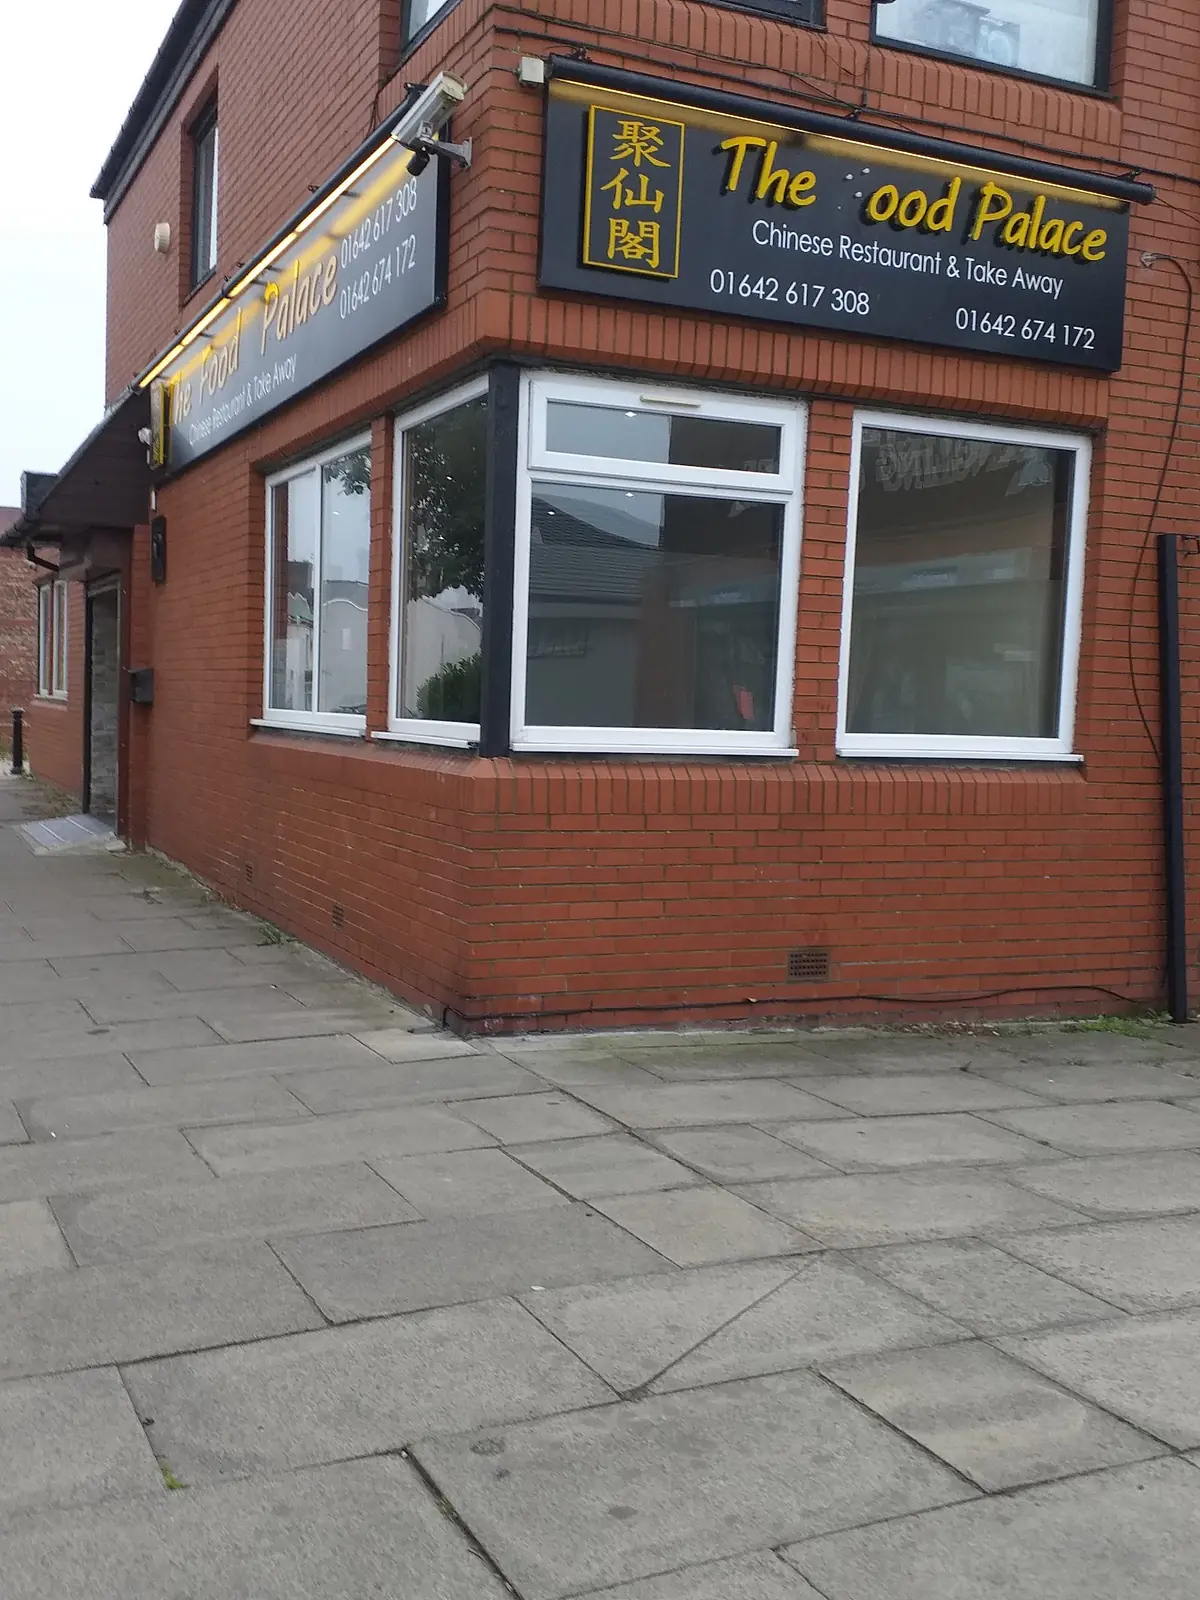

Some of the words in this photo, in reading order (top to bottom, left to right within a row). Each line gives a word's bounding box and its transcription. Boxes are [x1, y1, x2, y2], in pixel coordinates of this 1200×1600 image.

[341, 218, 371, 269] 01642
[373, 197, 393, 242] 617
[395, 176, 417, 223] 308
[600, 120, 672, 269] 聚仙閣
[721, 136, 817, 206] The
[972, 182, 1108, 261] Palace
[339, 271, 370, 319] 01642
[372, 253, 392, 295] 674
[396, 234, 416, 278] 172
[710, 269, 779, 301] 01642
[785, 282, 826, 308] 617
[831, 288, 870, 315] 308
[752, 219, 834, 256] Chinese
[839, 235, 942, 275] Restaurant
[946, 255, 961, 279] &
[965, 257, 1008, 286] Take
[1011, 267, 1064, 300] Away
[199, 307, 241, 405] Food
[261, 255, 338, 356] Palace
[955, 308, 1016, 337] 01642
[1021, 319, 1056, 344] 674
[1063, 325, 1096, 350] 172
[254, 372, 272, 400] Take
[272, 353, 297, 391] Away
